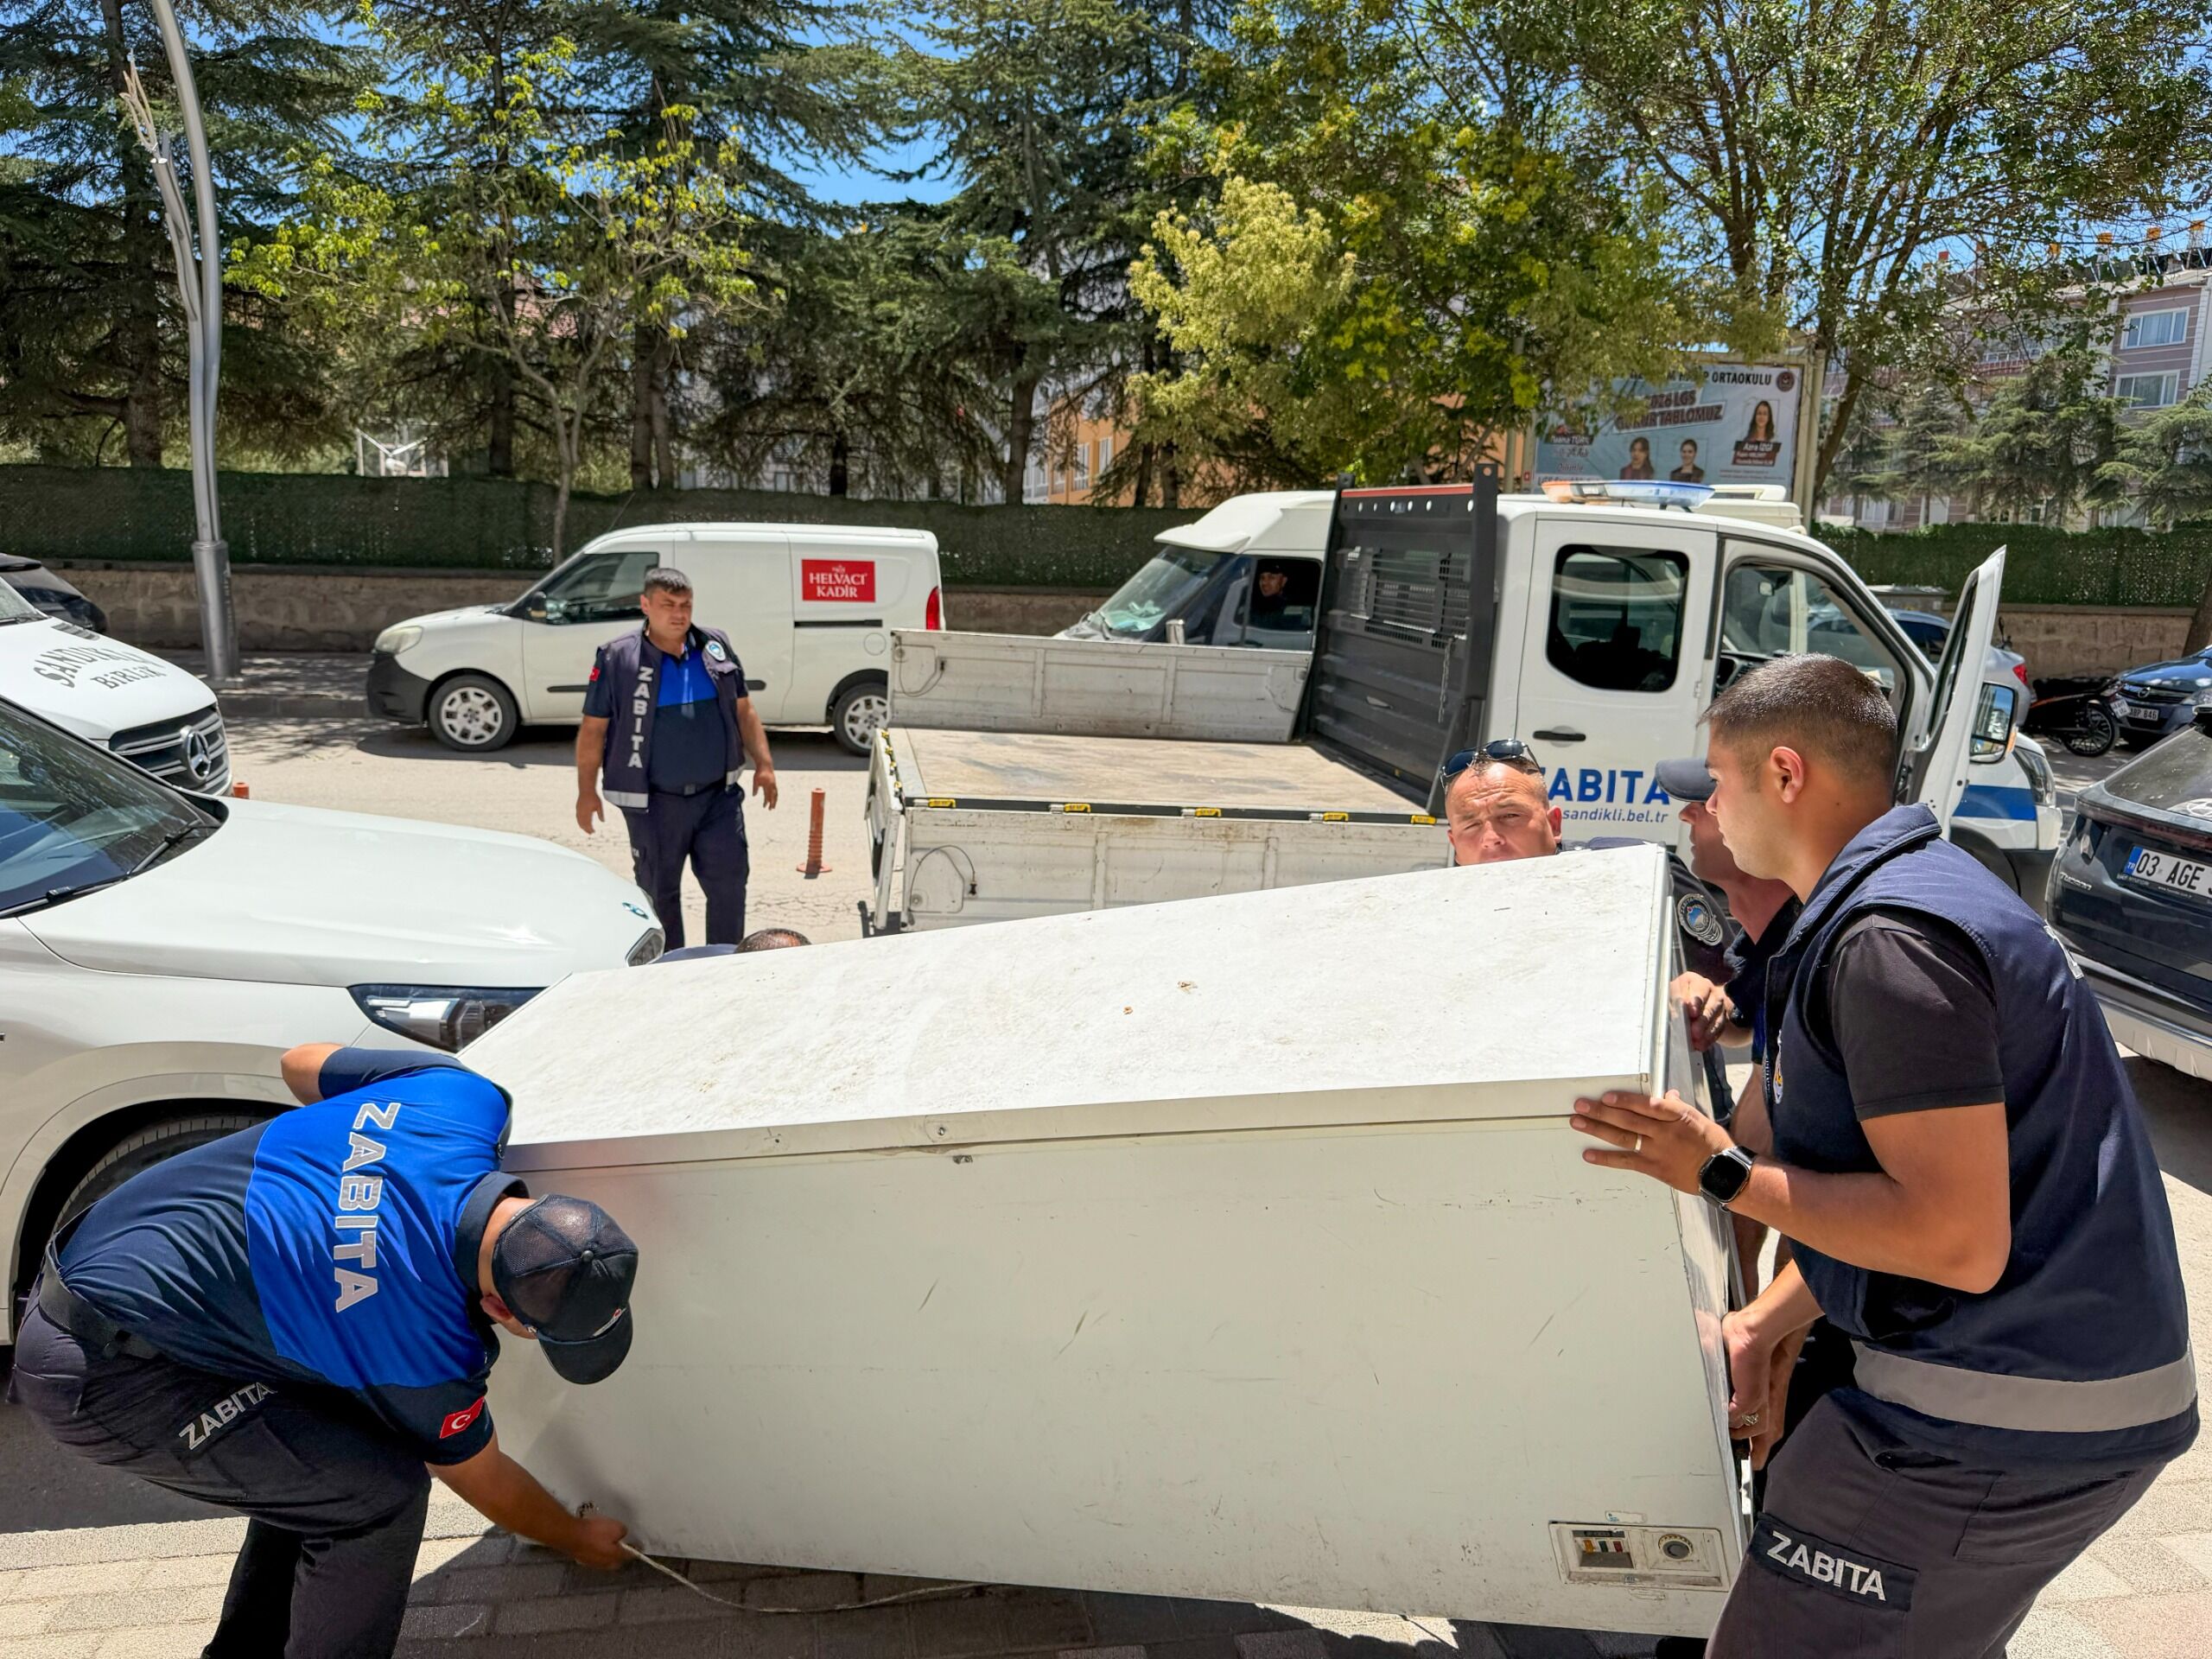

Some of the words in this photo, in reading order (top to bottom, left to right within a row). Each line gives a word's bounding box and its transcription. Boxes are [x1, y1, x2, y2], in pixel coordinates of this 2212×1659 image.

[1712, 371, 1771, 385] ORTAOKULU
[1648, 393, 1671, 409] 026
[1674, 391, 1696, 407] LGS
[1659, 405, 1723, 426] TABLOMUZ
[809, 572, 866, 586] HELVACI
[817, 584, 858, 598] KADİR
[627, 665, 655, 769] ZABITA
[1540, 766, 1670, 805] ABITA
[2136, 853, 2160, 877] 03
[2166, 861, 2205, 890] AGE
[334, 1102, 402, 1313] ZABITA
[178, 1382, 276, 1451] ZABITA
[1767, 1530, 1886, 1602] ZABITA
